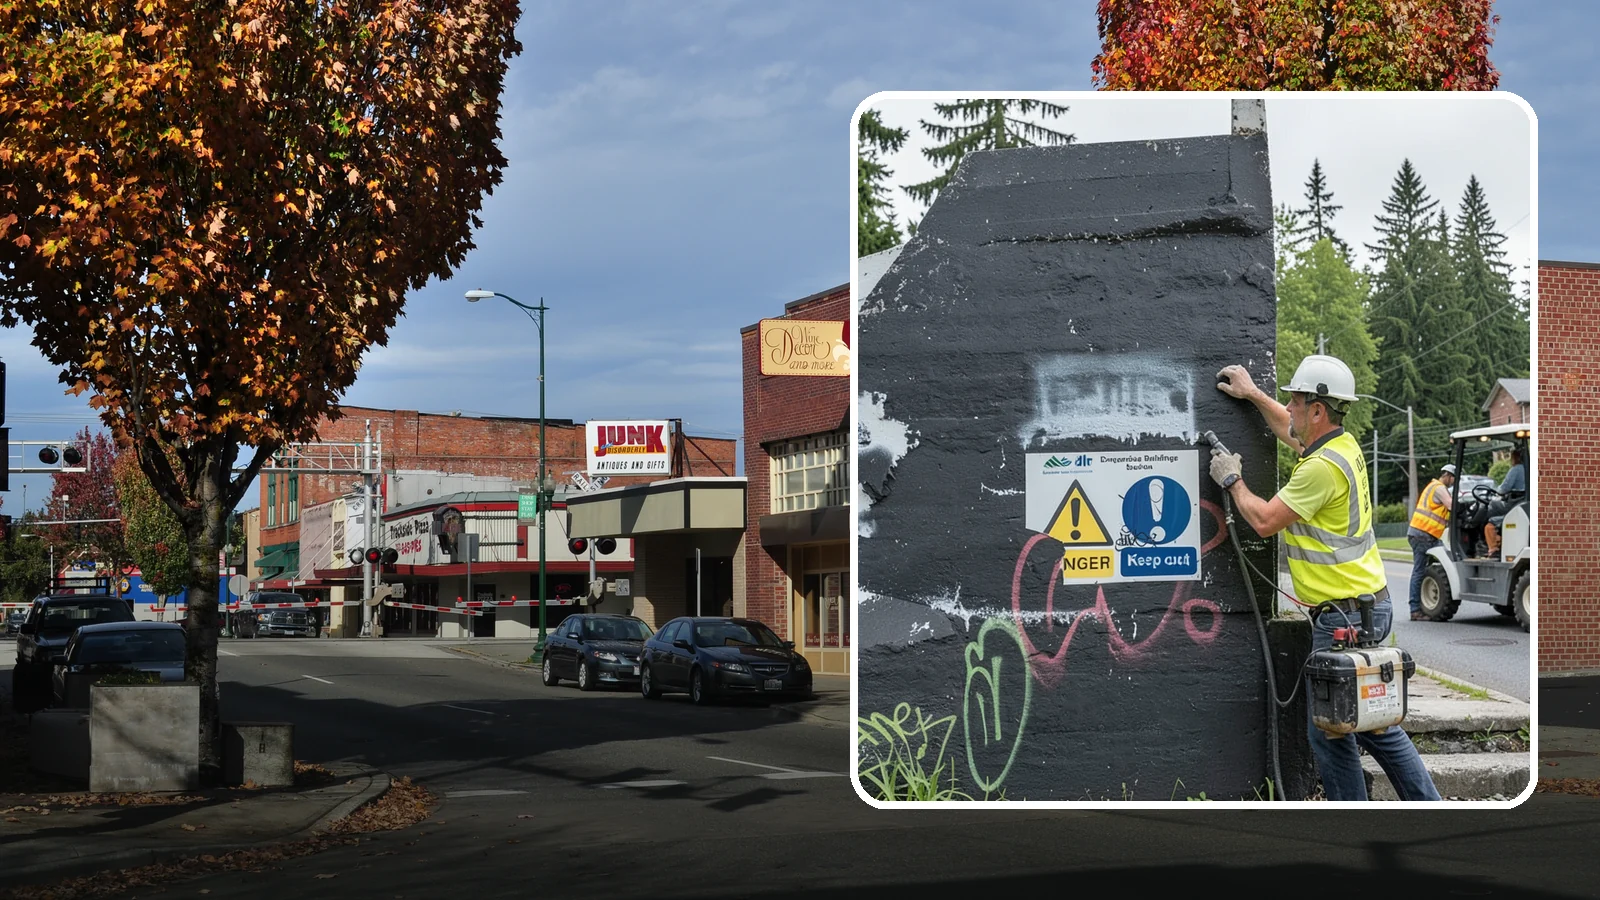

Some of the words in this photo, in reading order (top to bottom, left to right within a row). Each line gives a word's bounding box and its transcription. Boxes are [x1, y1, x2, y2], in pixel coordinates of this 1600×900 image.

[765, 327, 831, 366] Decor
[595, 425, 665, 457] JUNK
[607, 446, 646, 454] DISORDERLY
[596, 461, 628, 470] ANTIQUES
[630, 461, 644, 470] AND
[646, 460, 666, 469] GIFTS
[414, 519, 429, 535] Pizza
[1127, 553, 1161, 569] Keep
